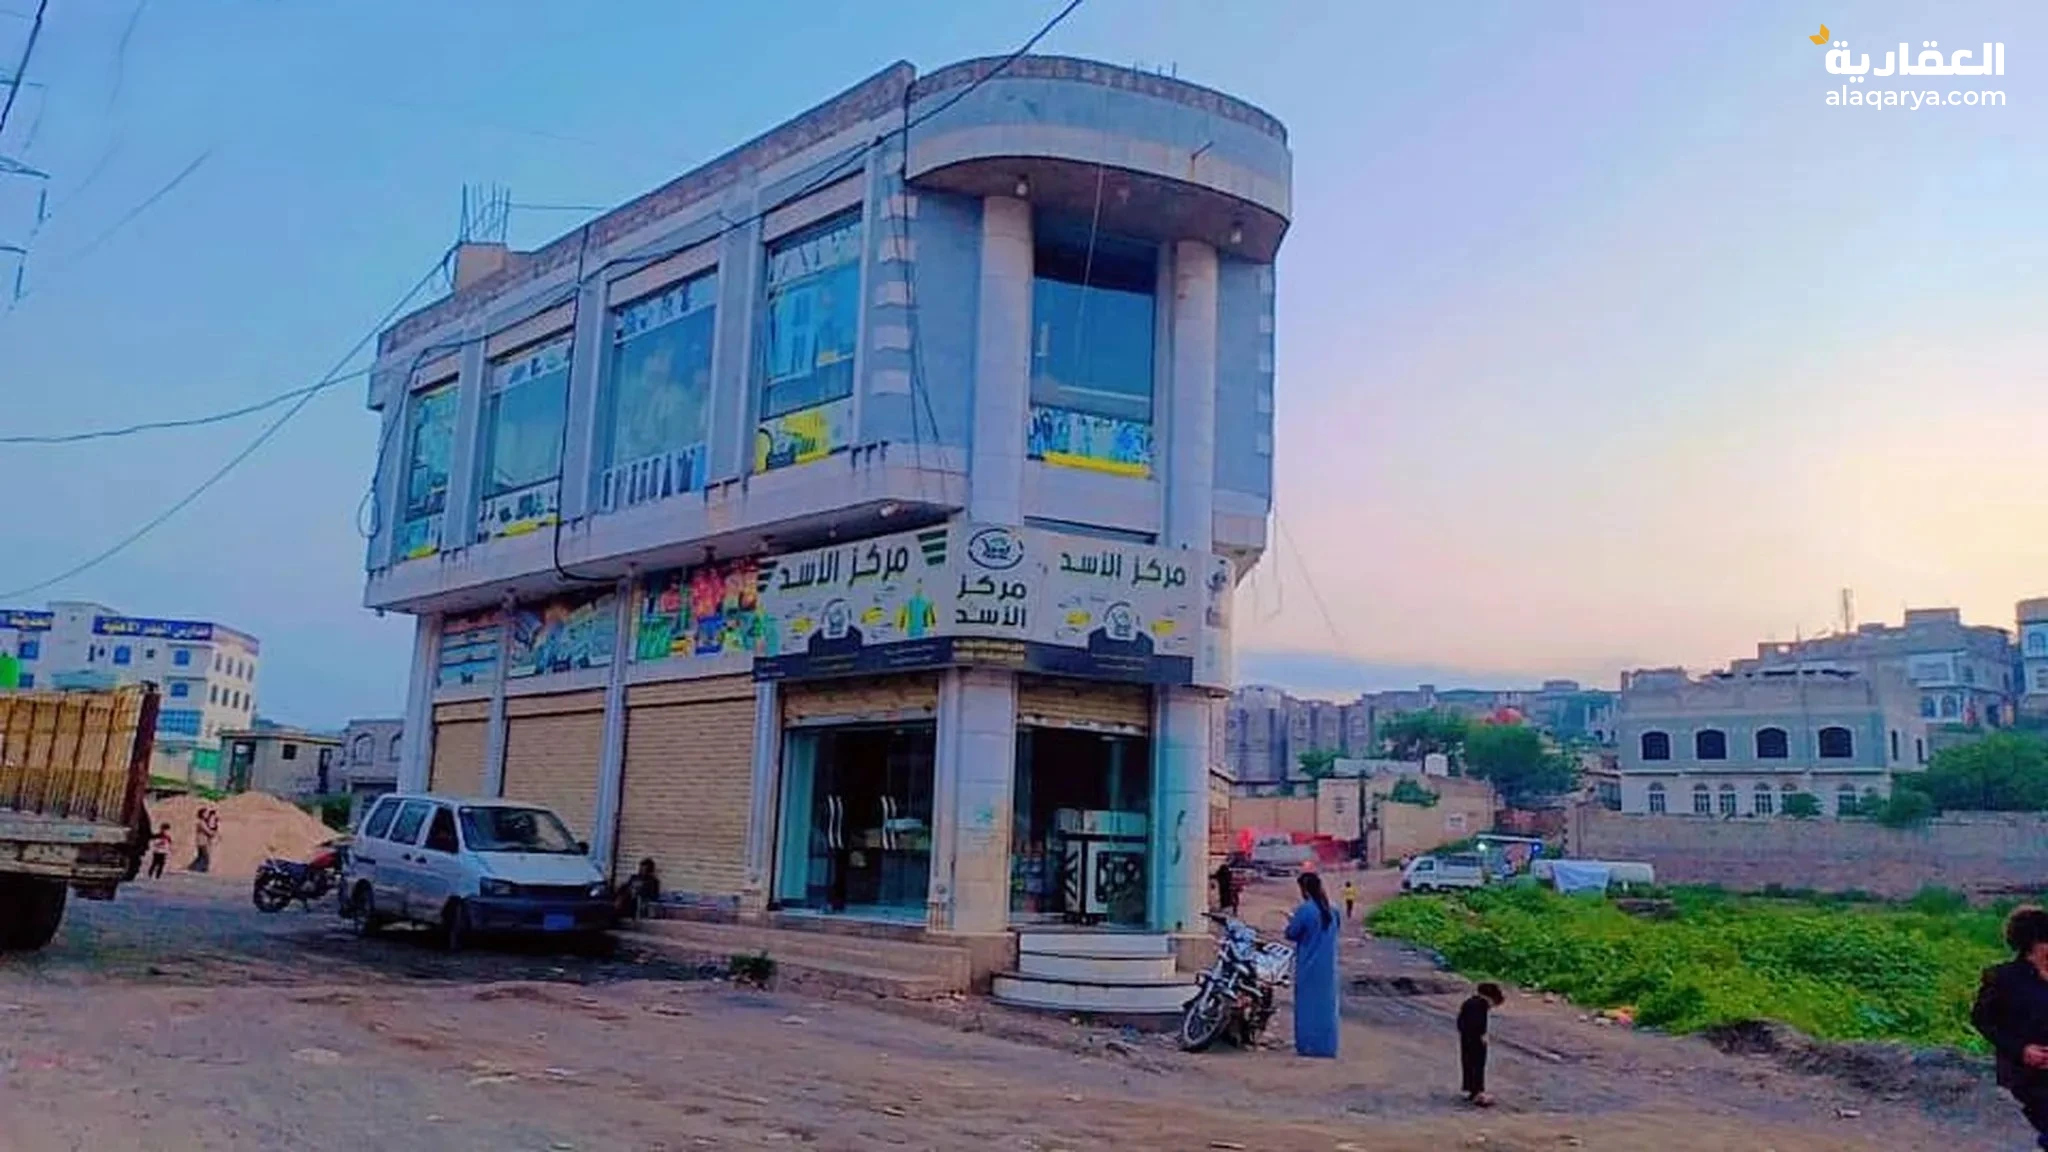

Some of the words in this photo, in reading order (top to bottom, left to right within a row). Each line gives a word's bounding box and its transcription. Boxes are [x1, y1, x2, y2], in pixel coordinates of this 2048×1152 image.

[847, 543, 909, 588] مركز
[1130, 554, 1186, 588] مركز
[955, 573, 1027, 600] مركز
